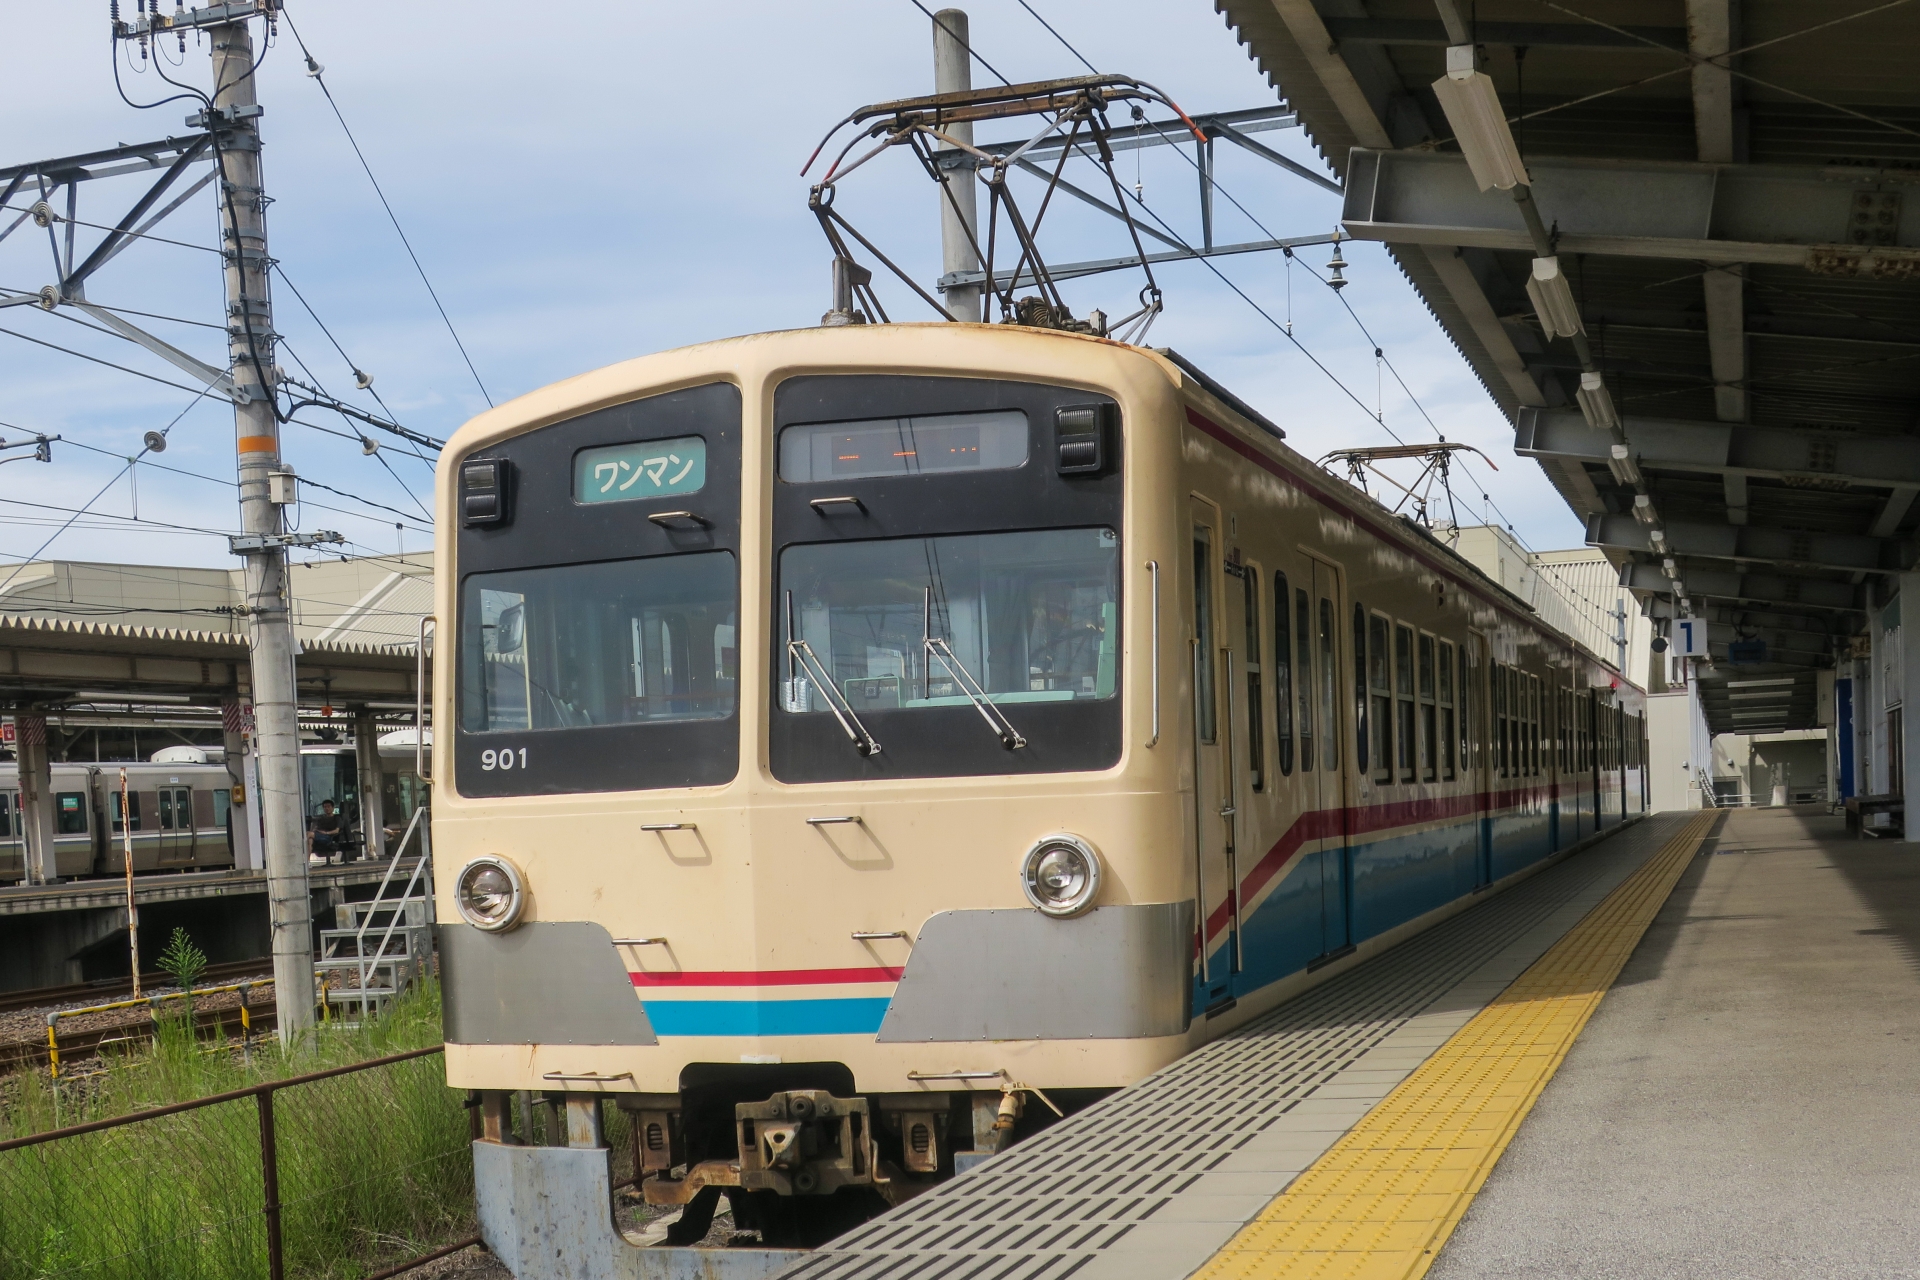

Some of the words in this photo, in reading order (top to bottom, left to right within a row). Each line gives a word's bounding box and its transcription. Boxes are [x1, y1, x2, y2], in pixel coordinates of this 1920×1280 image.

[595, 454, 693, 493] ワンマン
[1680, 622, 1692, 652] 1
[481, 748, 526, 770] 901
[386, 784, 395, 793] JR
